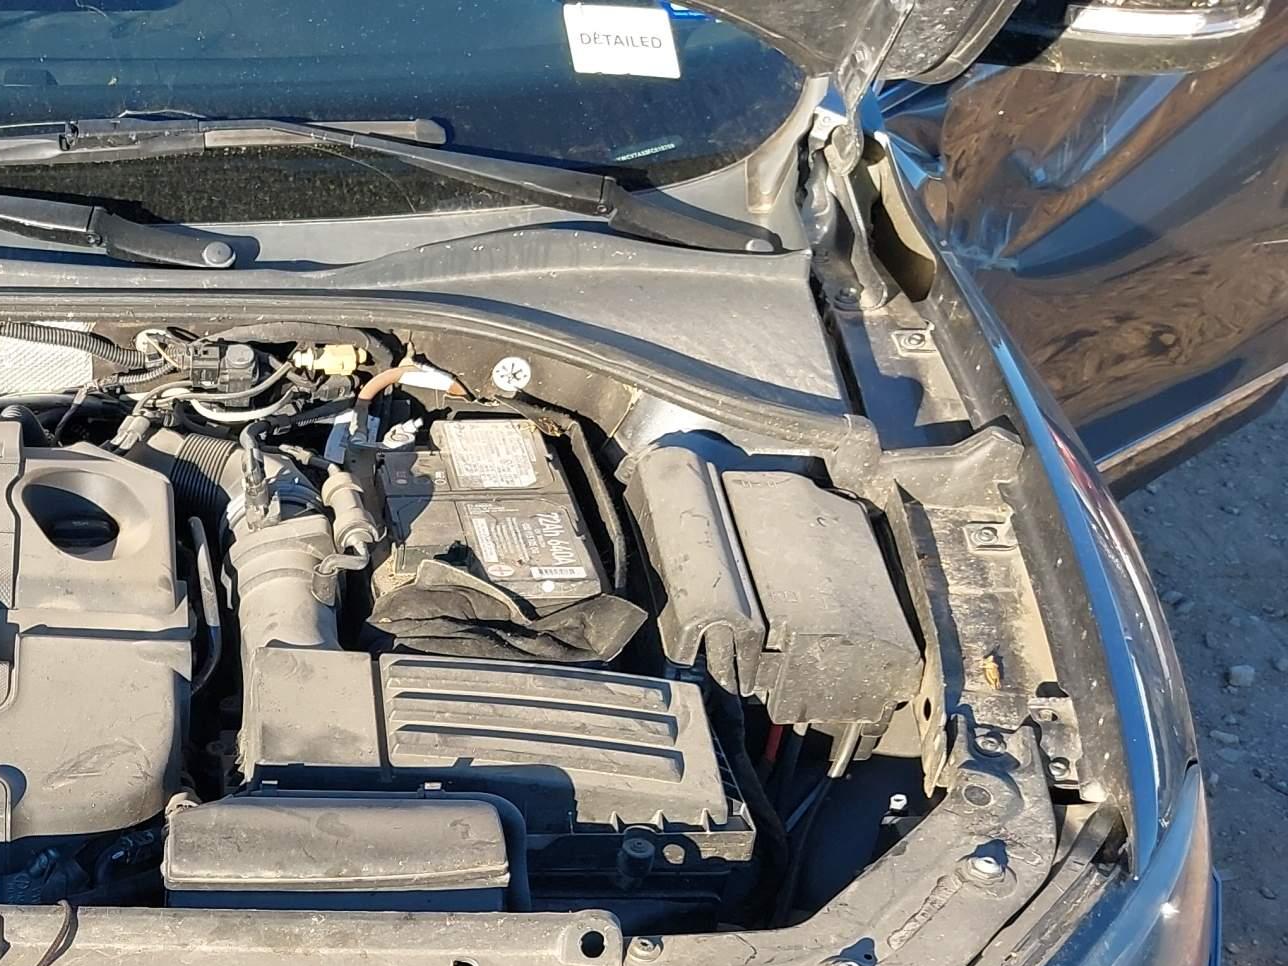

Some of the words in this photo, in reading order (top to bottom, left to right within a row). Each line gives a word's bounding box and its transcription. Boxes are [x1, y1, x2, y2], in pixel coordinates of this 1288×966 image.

[579, 32, 662, 49] DETAILED
[534, 511, 565, 538] 72Ah
[547, 538, 577, 566] 640A
